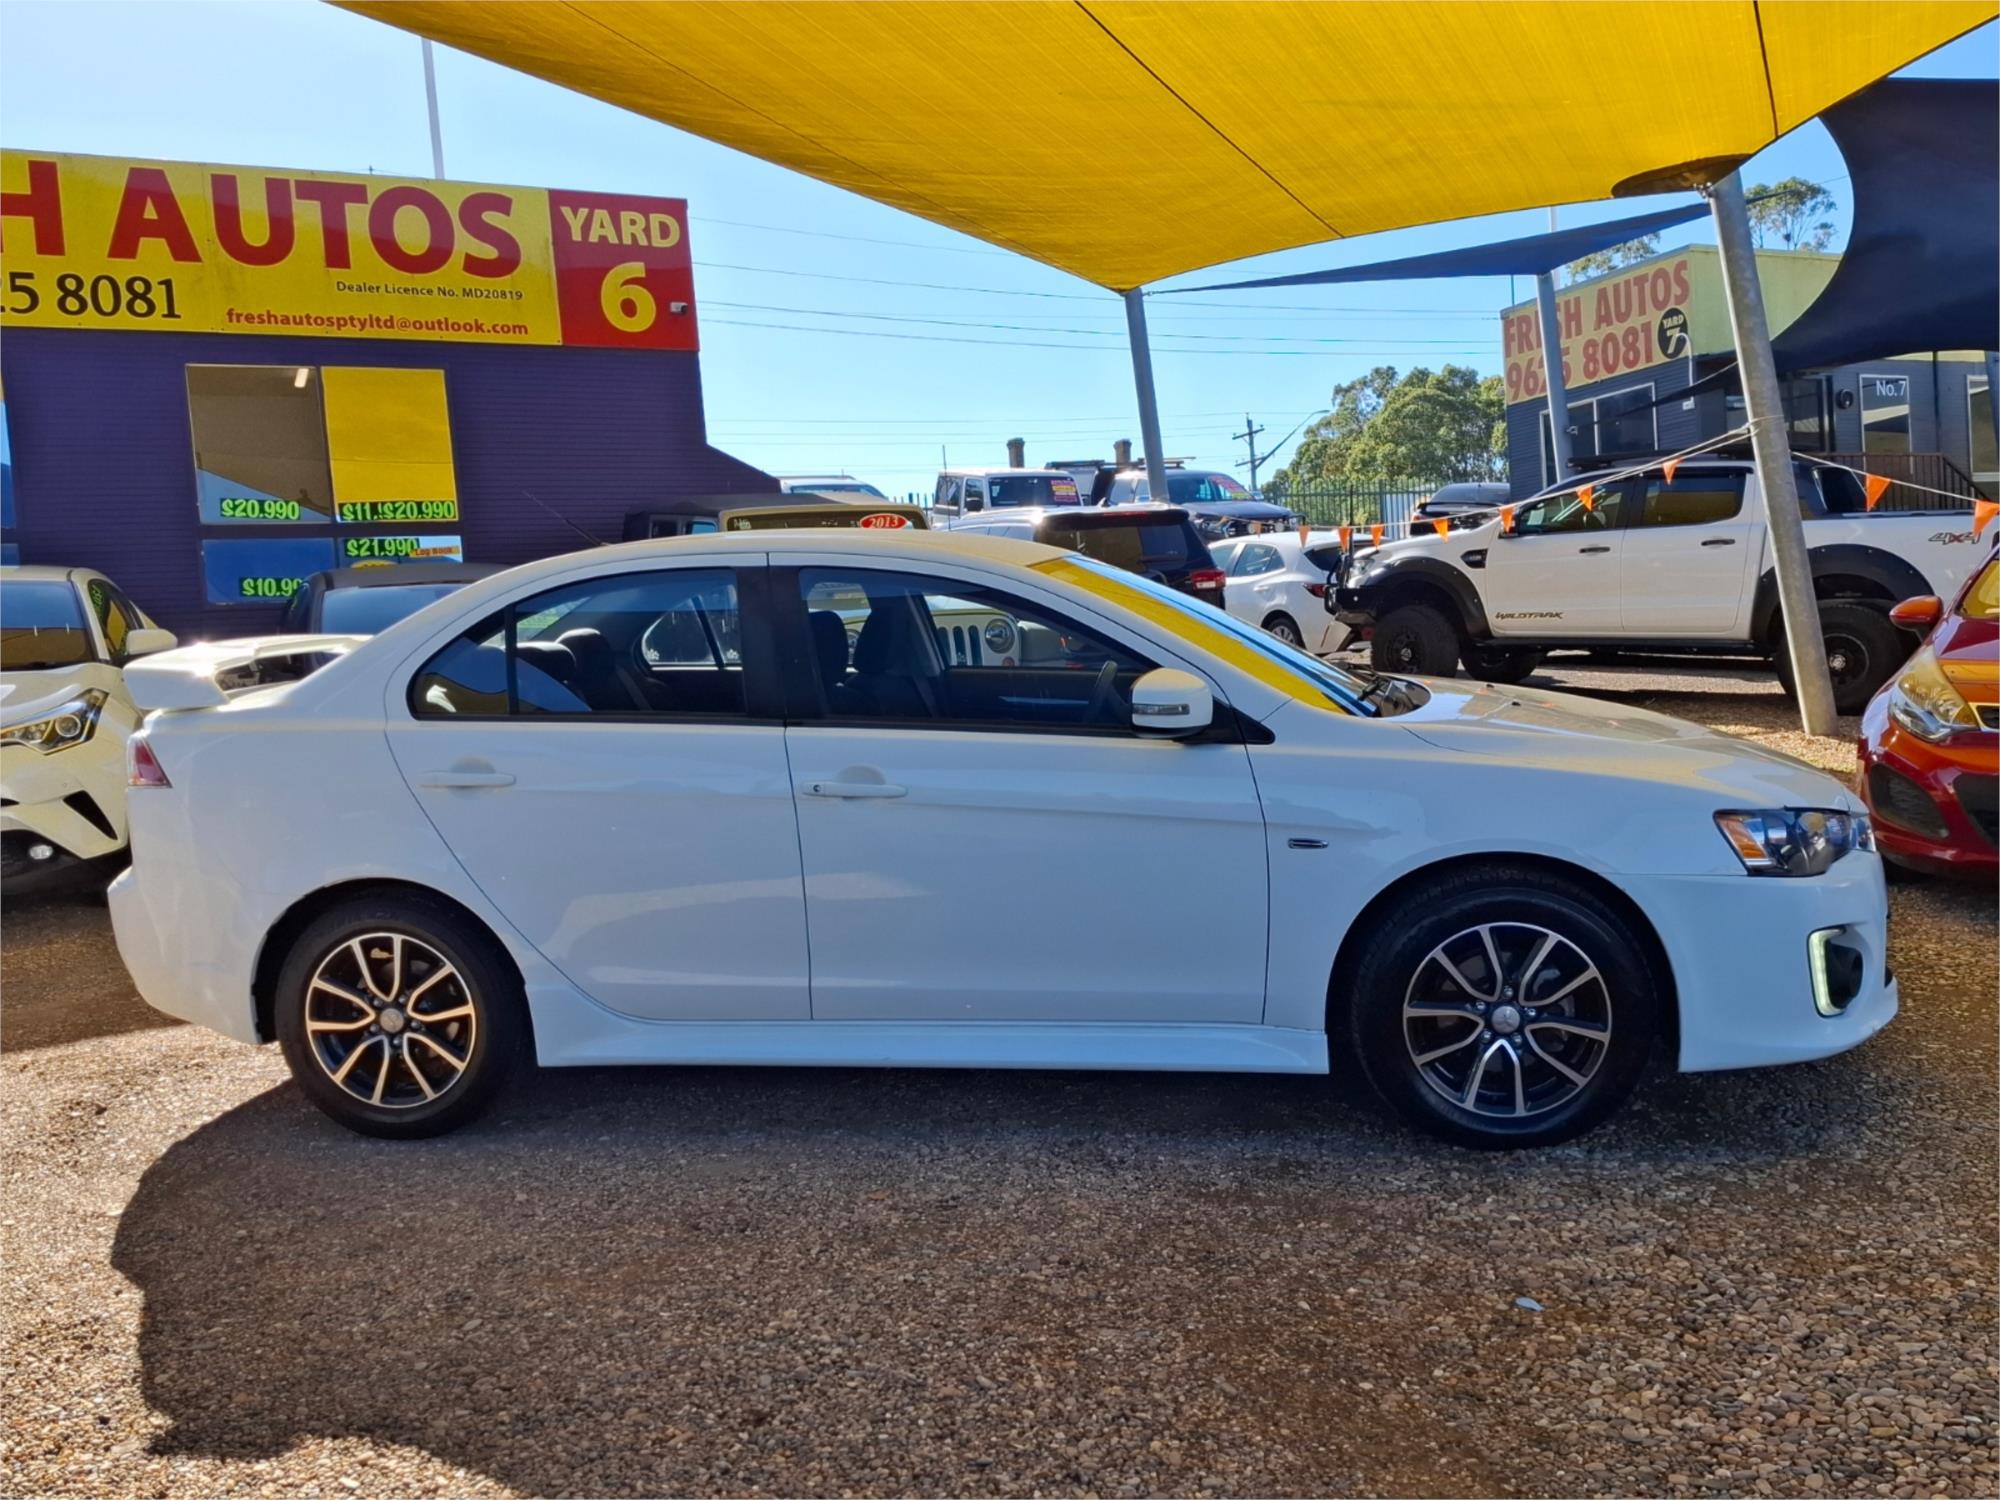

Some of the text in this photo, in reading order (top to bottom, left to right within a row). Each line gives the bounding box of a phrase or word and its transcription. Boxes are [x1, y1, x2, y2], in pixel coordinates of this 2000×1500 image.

[107, 167, 521, 279] AUTOS
[560, 206, 681, 248] YARD
[0, 271, 181, 319] 5 8081
[336, 280, 523, 301] Dealer Licence No. MD20819
[600, 262, 656, 332] 6
[1594, 260, 1690, 331] AUTOS
[226, 307, 529, 336] freshautosptyltd@outlook.com
[1662, 314, 1684, 329] YARD
[1582, 321, 1653, 381] 8081
[1666, 327, 1681, 354] 7
[1875, 379, 1906, 397] No. 7
[221, 499, 300, 519] $20.990
[383, 501, 455, 520] $20.990
[869, 518, 898, 528] 2013
[346, 538, 416, 557] $21.990
[1495, 612, 1563, 620] WILDTRAK
